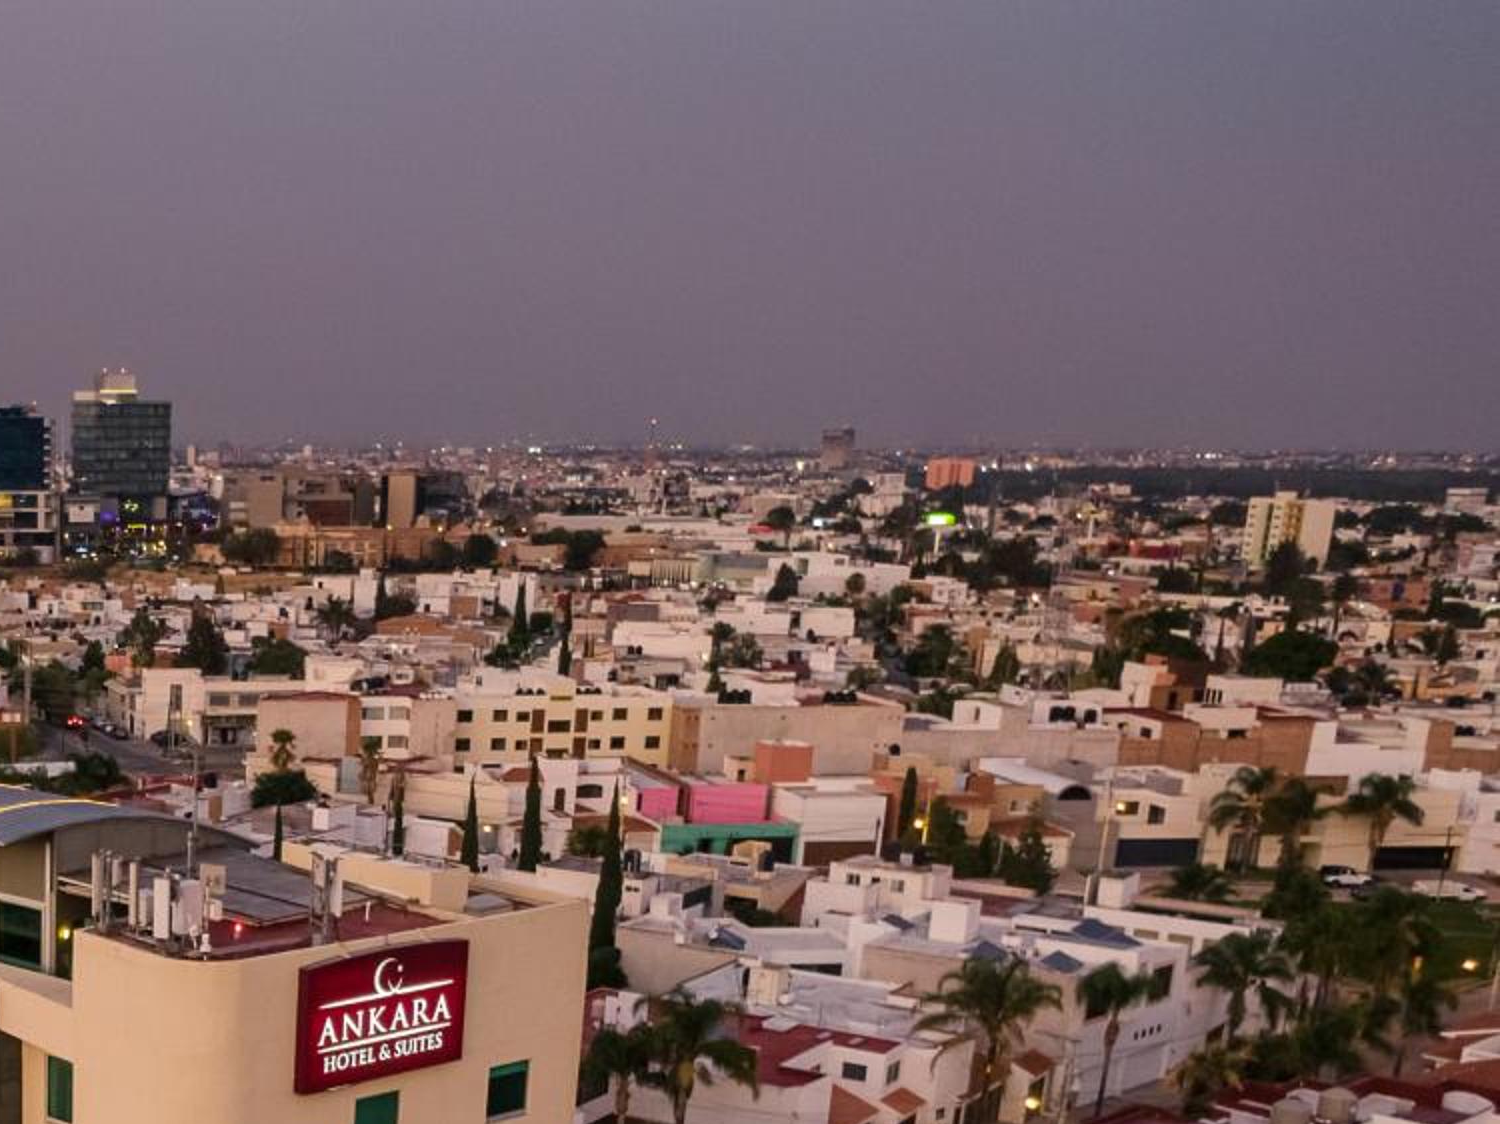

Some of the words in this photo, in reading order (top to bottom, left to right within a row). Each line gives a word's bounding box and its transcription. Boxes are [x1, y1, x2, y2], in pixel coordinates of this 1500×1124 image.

[317, 994, 452, 1047] ANKARA
[323, 1047, 376, 1074] HOTEL
[378, 1044, 391, 1061] &
[394, 1031, 443, 1057] SUITES
